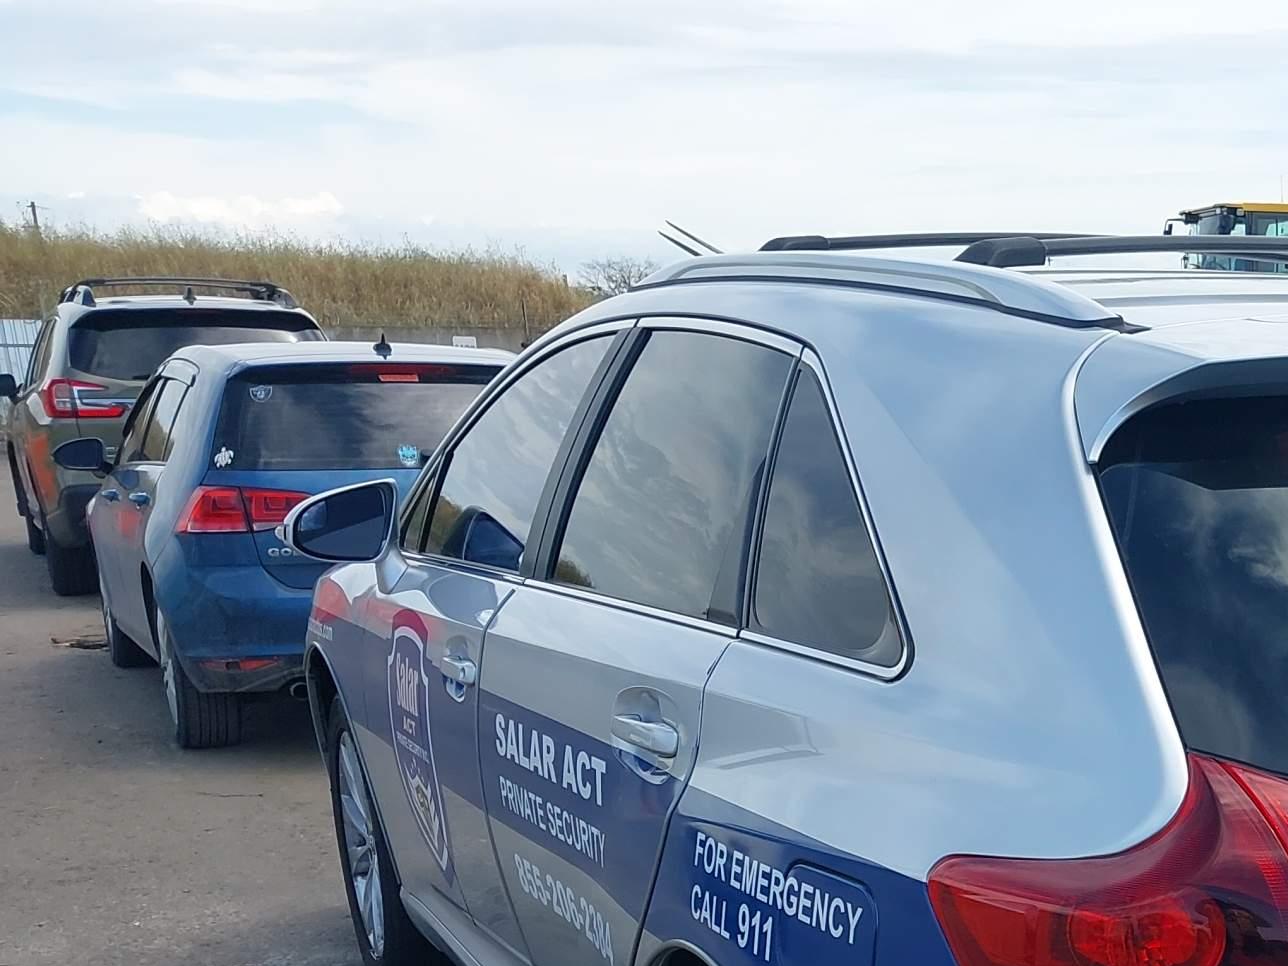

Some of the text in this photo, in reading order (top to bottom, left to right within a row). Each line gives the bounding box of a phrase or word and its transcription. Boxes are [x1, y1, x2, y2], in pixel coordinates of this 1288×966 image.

[396, 652, 419, 717] Salar
[495, 713, 556, 784] SALAR
[562, 746, 606, 806] ACT
[500, 776, 605, 868] PRIVATE SECURITY
[690, 885, 774, 962] CALL 911
[694, 831, 864, 945] FOR EMERGENCY
